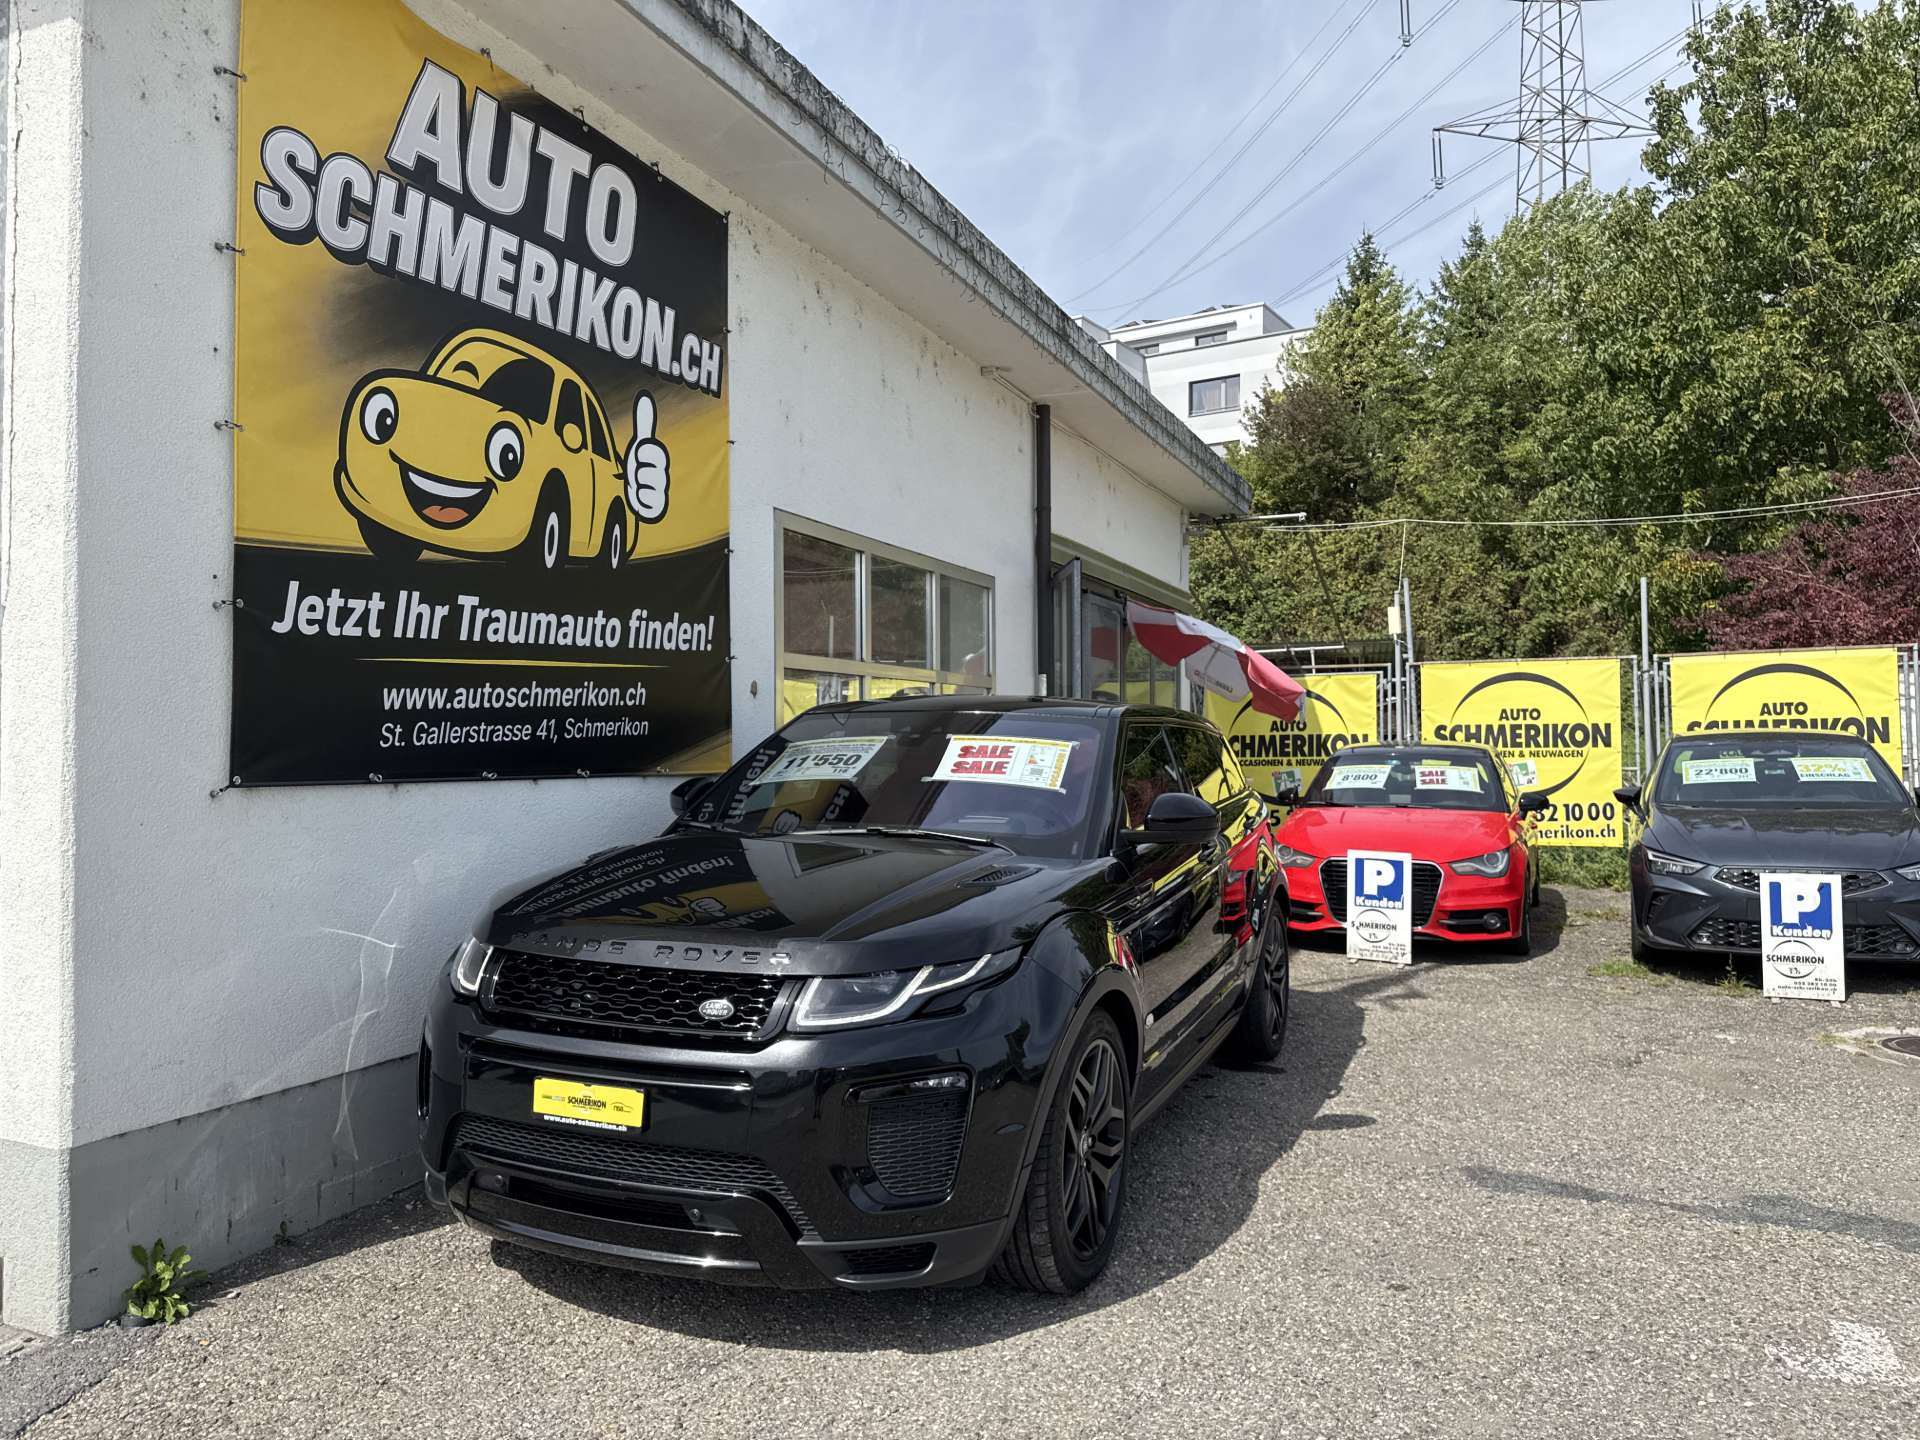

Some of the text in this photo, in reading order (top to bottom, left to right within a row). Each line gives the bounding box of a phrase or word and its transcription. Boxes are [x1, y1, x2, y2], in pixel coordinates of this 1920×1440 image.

[387, 58, 638, 267] AUTO
[256, 128, 722, 394] SCHMERIKON.CH
[271, 580, 715, 652] Jetzt Ihr Traumauto finden!
[383, 681, 646, 710] www.autoschmerikon.ch
[1499, 708, 1541, 721] AUTO
[1760, 701, 1808, 716] AUTO
[379, 717, 649, 748] St. Gallerstrasse 41, Schmerikon
[1269, 720, 1307, 733] AUTO
[1434, 722, 1612, 749] SCHMERIKON
[958, 745, 1016, 759] SALE
[1229, 733, 1368, 758] CHMERIKO
[1529, 750, 1584, 758] NEUWAGEN
[951, 761, 1009, 775] SALE
[1238, 759, 1283, 767] CCASIONEN
[1355, 896, 1403, 909] Kunden
[1772, 924, 1832, 940] Kunden
[653, 944, 792, 966] ROVER
[1766, 954, 1825, 964] SCHMERIKON
